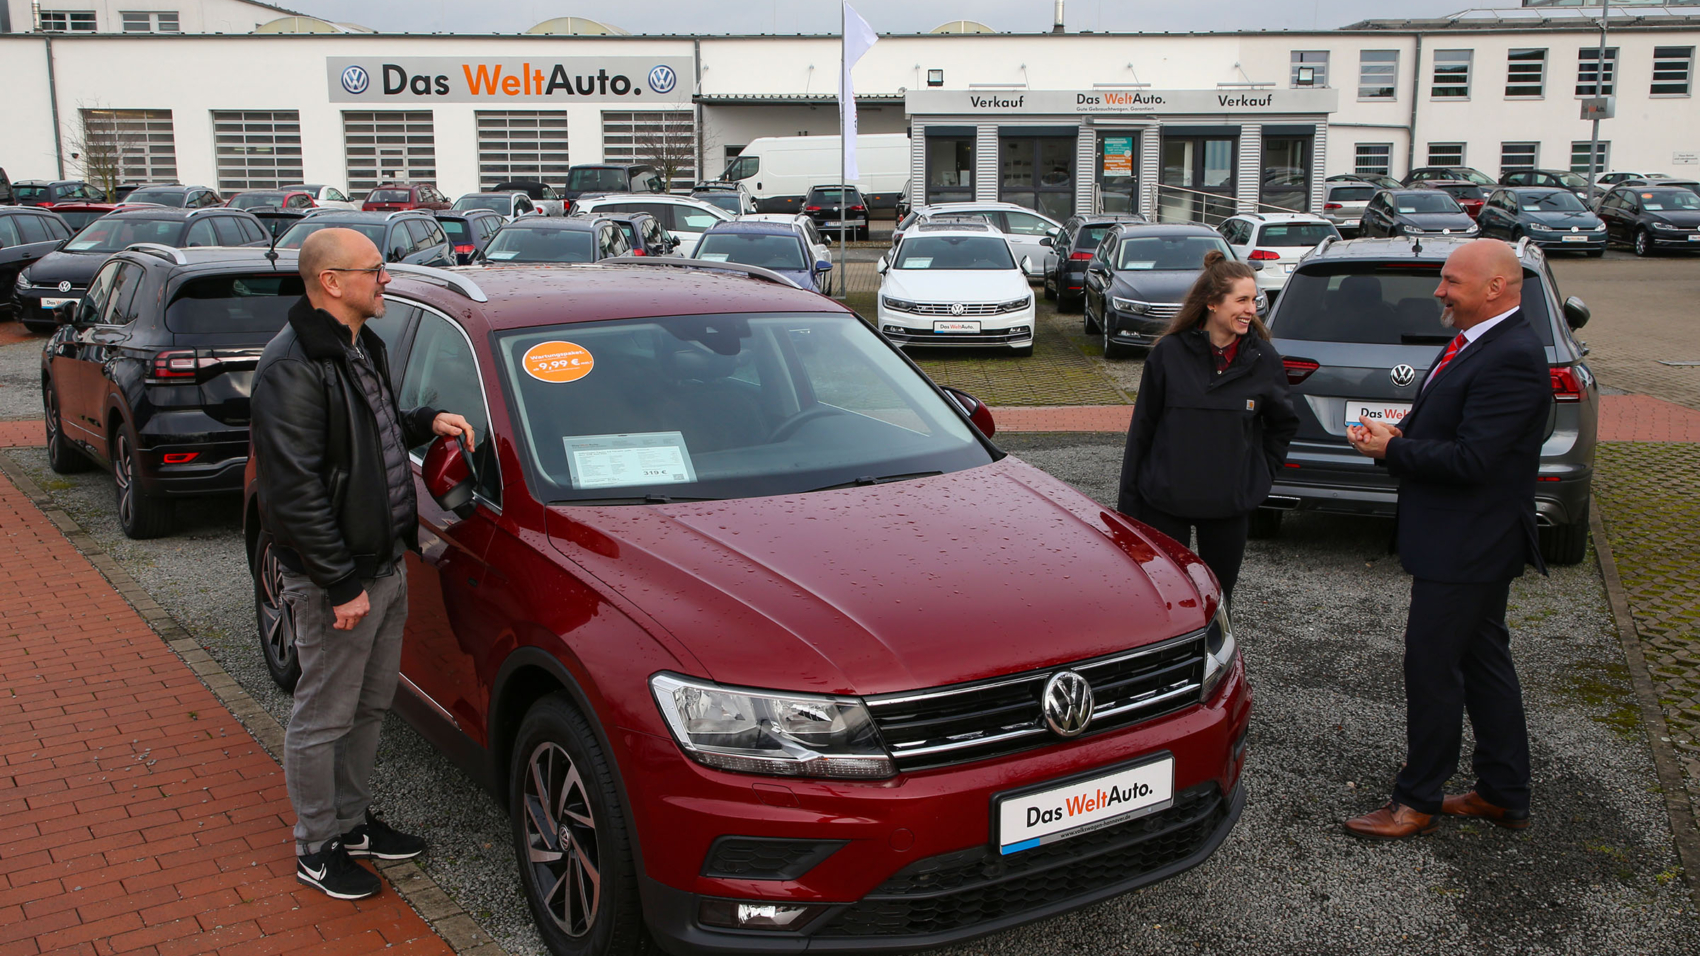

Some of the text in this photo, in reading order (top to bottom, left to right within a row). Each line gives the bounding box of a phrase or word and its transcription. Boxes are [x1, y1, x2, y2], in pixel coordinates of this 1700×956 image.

[382, 62, 642, 96] Das WeltAuto.
[970, 95, 1024, 108] Verkauf
[1076, 92, 1166, 105] Das WeltAuto.
[1217, 93, 1273, 107] Verkauf
[530, 350, 585, 360] Wartungspaket.
[539, 359, 568, 371] 9,99
[571, 358, 580, 366] €
[1361, 407, 1383, 419] Das
[1026, 782, 1154, 828] Das WeltAuto.
[1060, 814, 1131, 839] www.volkswagen-hannover.de
